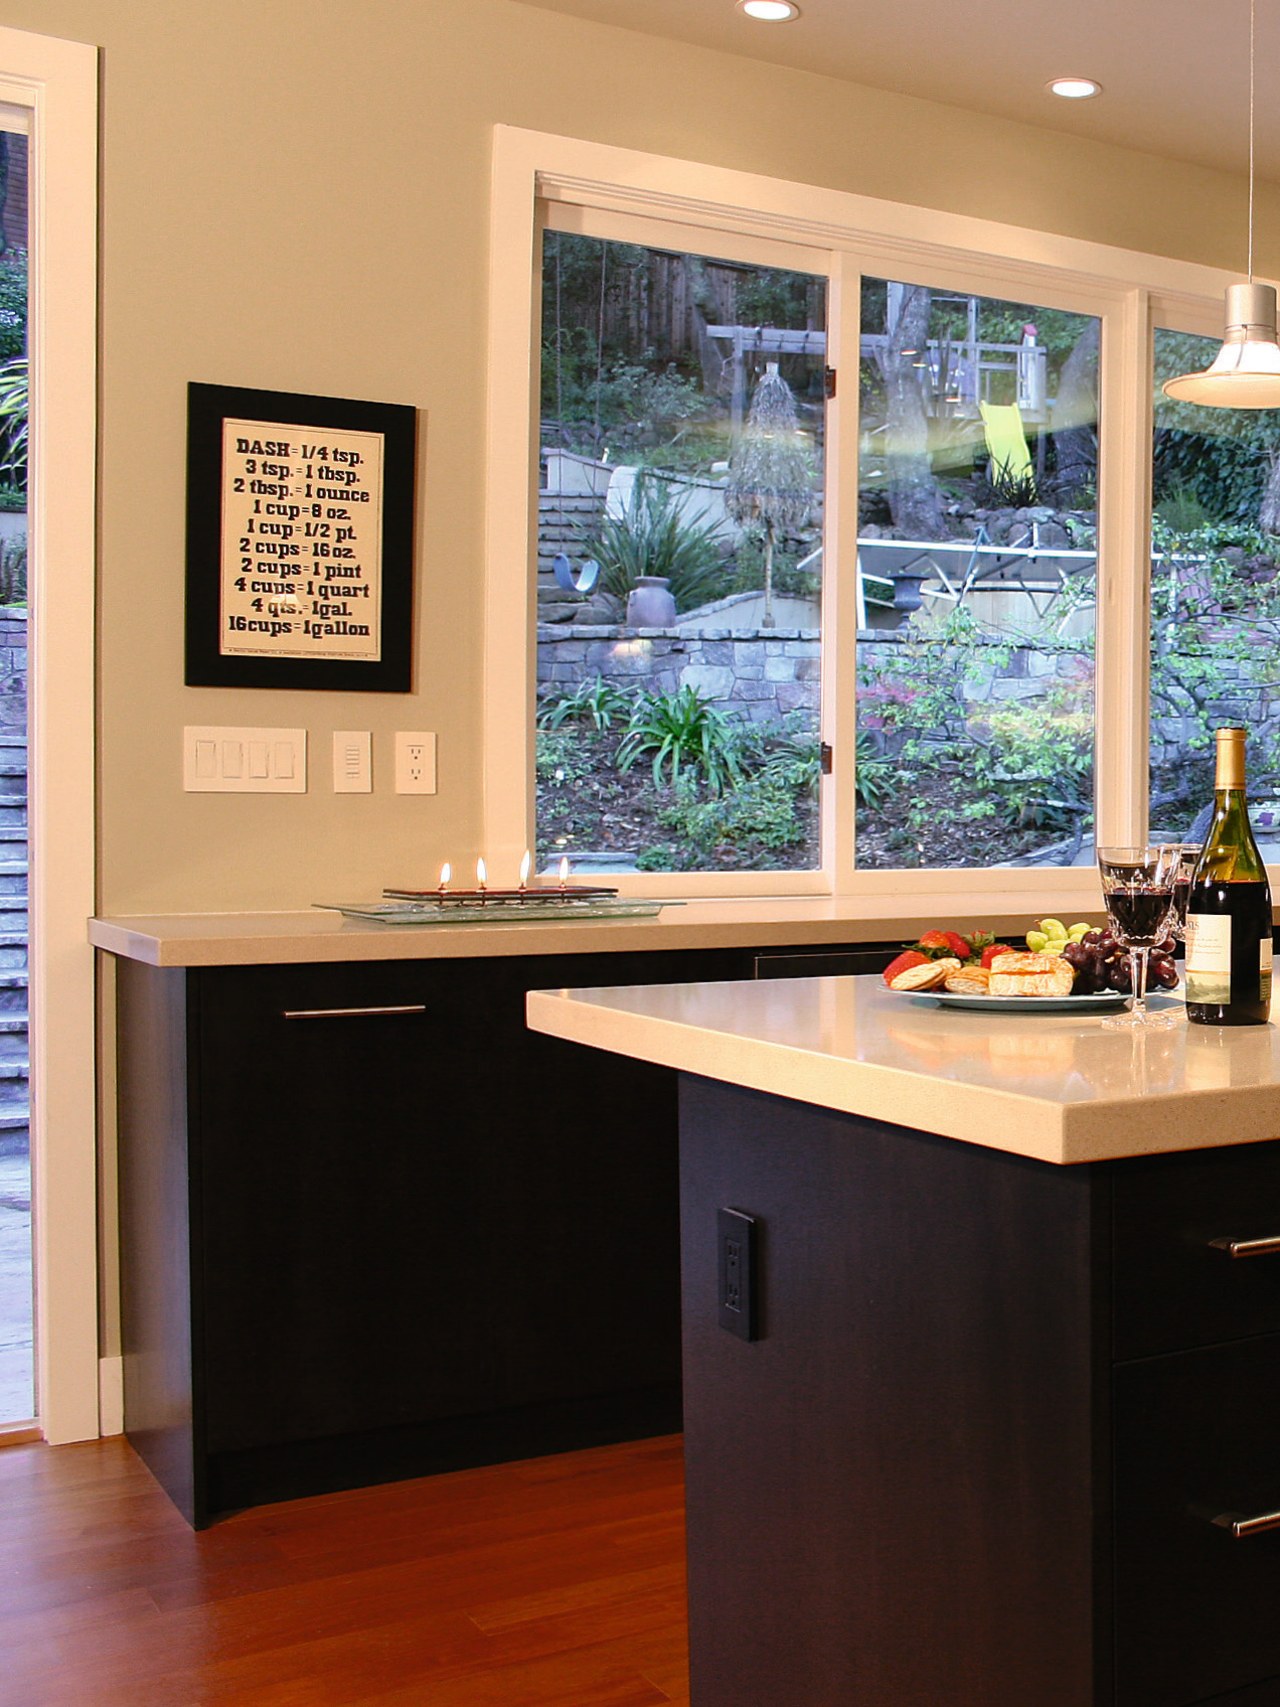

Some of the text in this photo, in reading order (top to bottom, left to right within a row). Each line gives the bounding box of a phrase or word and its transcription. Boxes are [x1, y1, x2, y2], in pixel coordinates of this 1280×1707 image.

[237, 439, 290, 457] DASH
[302, 445, 328, 460] 1/4
[333, 448, 364, 467] tsp.
[246, 460, 256, 473] 3
[262, 462, 294, 480] tsp.
[318, 466, 360, 486] tbsp.
[234, 479, 244, 492] 2
[250, 480, 293, 499] tbsp.
[317, 487, 369, 502] ounce
[266, 504, 299, 520] cup
[312, 504, 322, 517] 8
[260, 523, 293, 539] cup
[305, 523, 330, 537] 1/2
[240, 539, 250, 552] 2
[256, 543, 300, 559] cups
[242, 558, 252, 572] 2
[258, 563, 301, 578] cups
[325, 564, 361, 581] pint
[235, 577, 246, 591] 4
[319, 584, 369, 600] quart
[251, 598, 263, 612] 4
